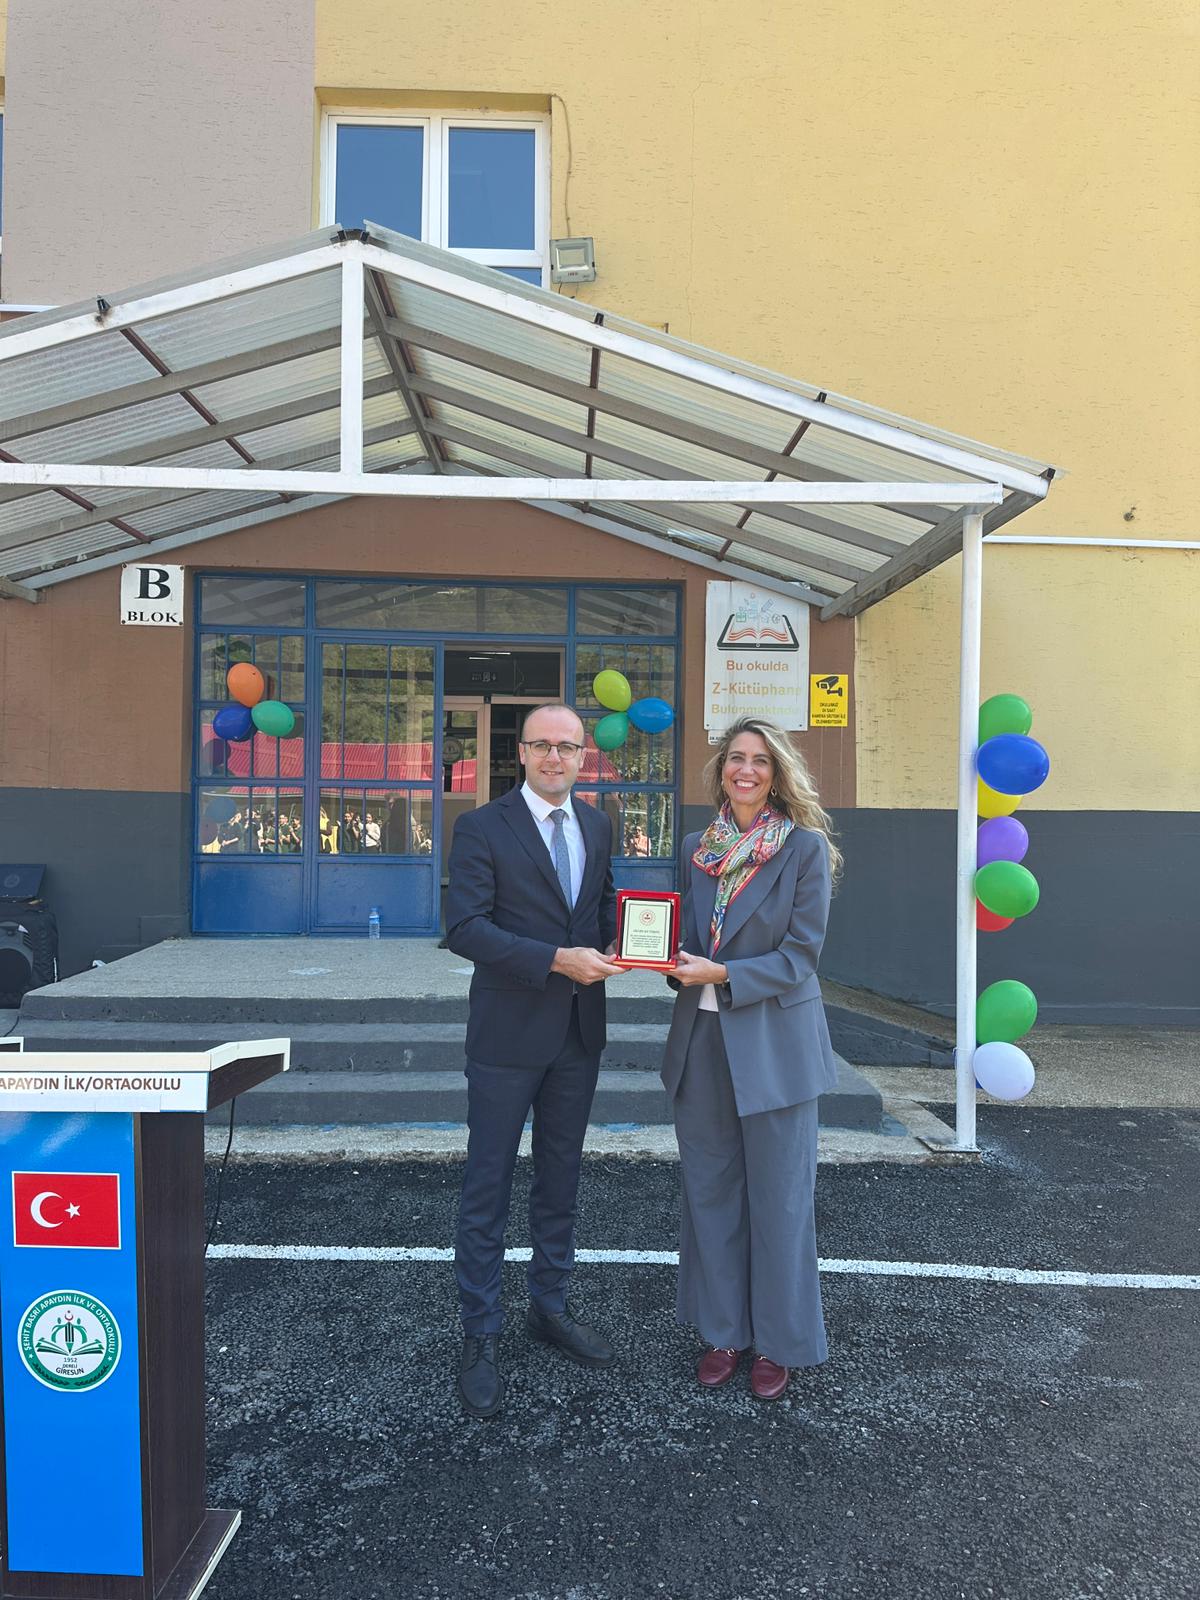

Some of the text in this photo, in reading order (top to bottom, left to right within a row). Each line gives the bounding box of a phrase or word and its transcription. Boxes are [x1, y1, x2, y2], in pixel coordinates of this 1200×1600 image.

[134, 567, 171, 599] B
[127, 611, 178, 623] BLOK
[726, 660, 789, 671] Bu okulda
[0, 1075, 181, 1092] APAYDIN İLK/ORTAOKULU
[23, 1295, 116, 1354] ŞEHİT BASRİ APAYDIN İLK VE ORTAOKULU
[55, 1367, 85, 1376] GİRESUN
